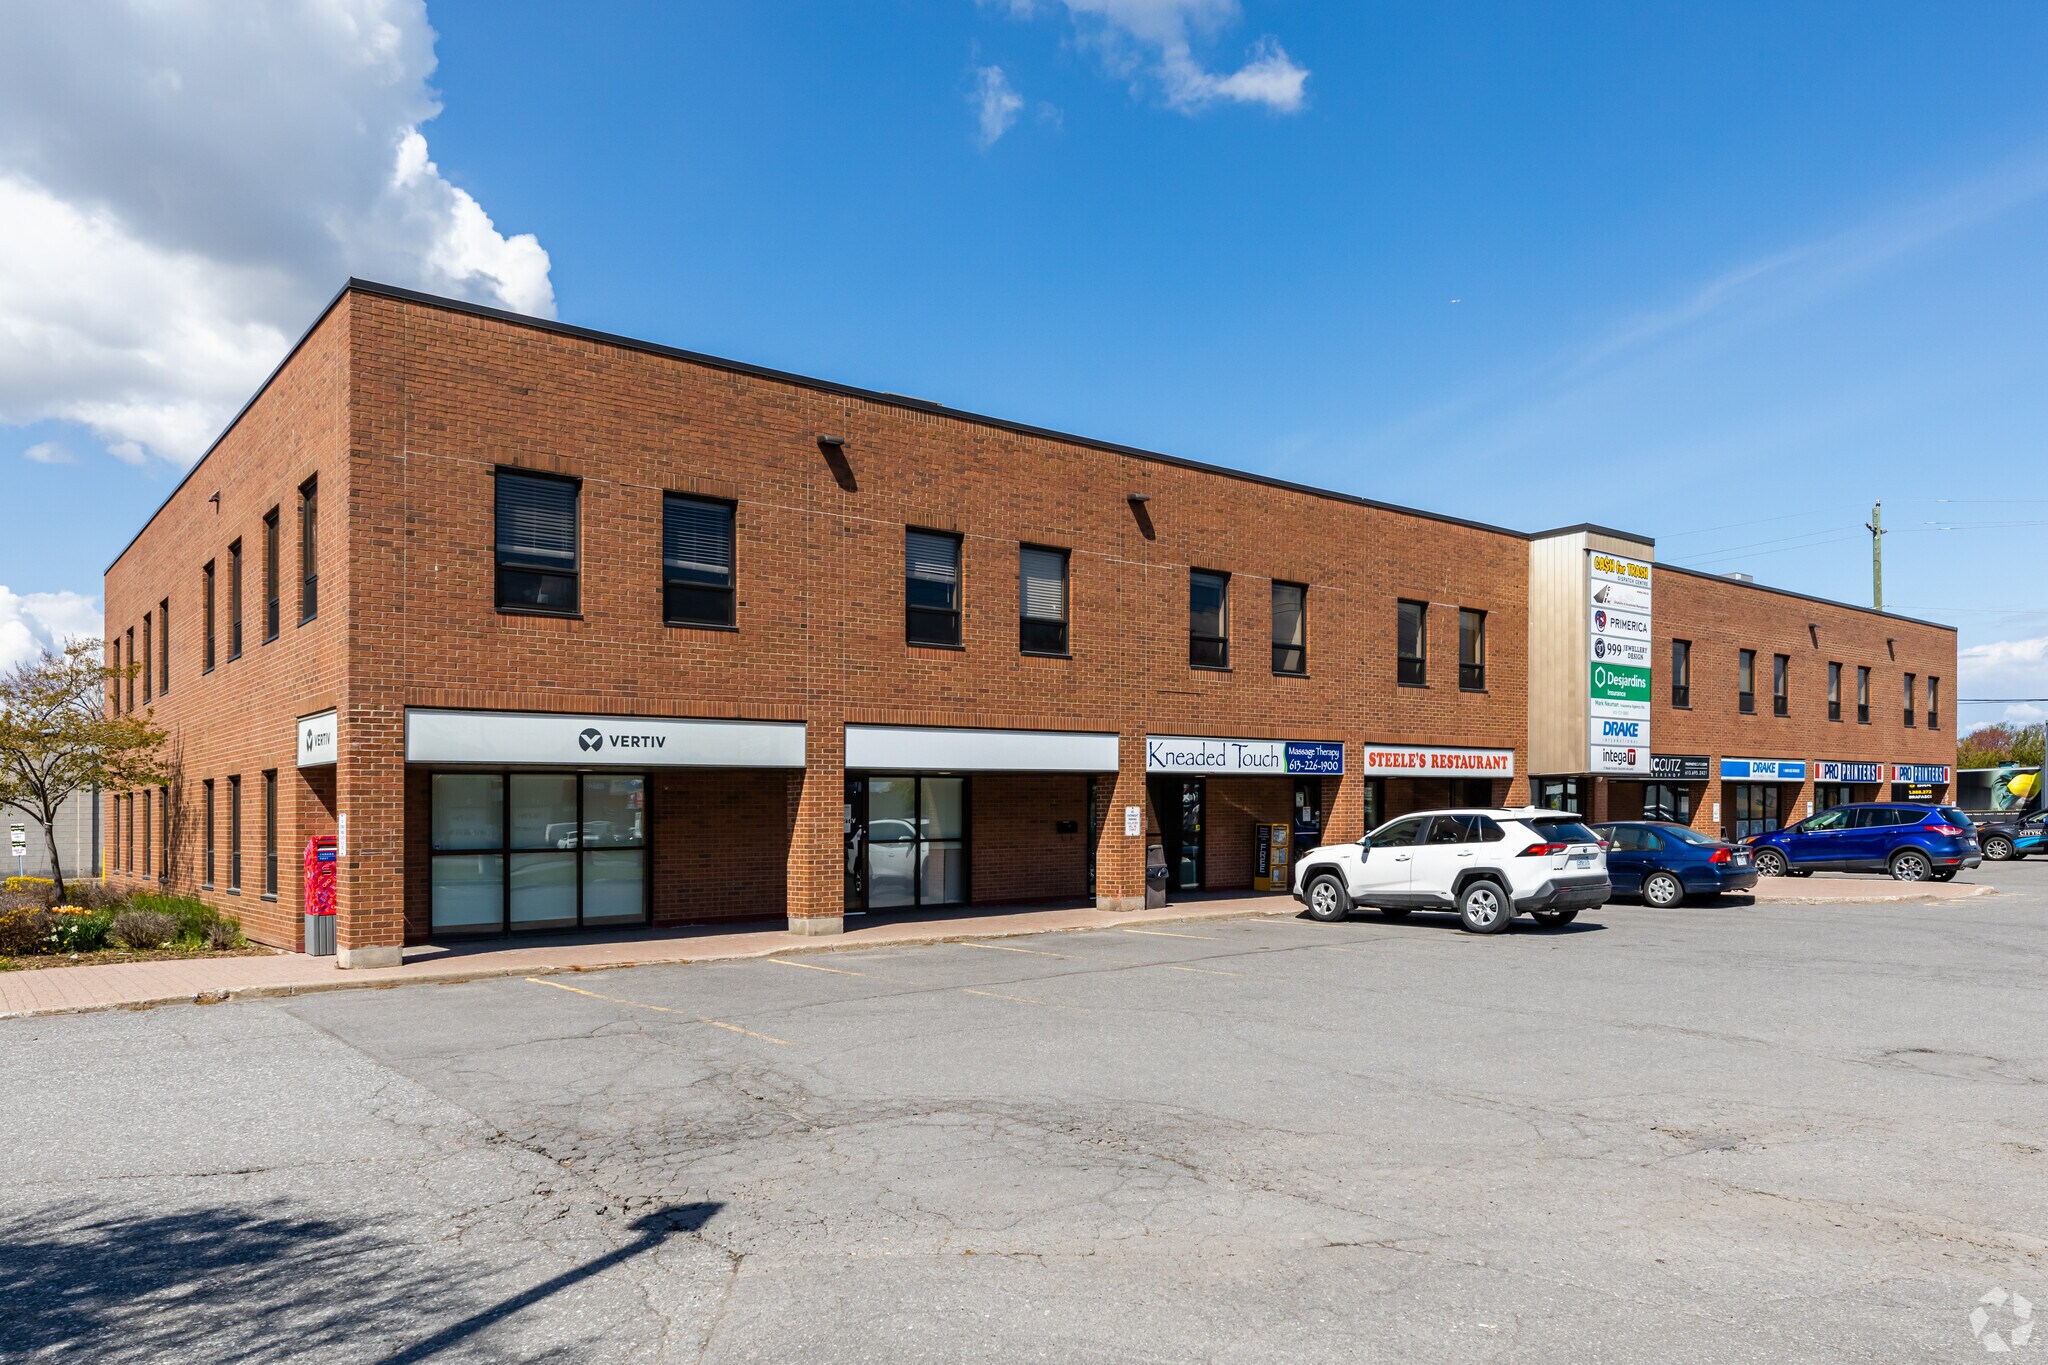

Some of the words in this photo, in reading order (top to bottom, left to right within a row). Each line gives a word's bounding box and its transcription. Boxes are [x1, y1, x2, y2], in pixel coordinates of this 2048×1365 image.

[1616, 561, 1626, 575] for
[1627, 563, 1649, 580] TRASH
[1617, 576, 1634, 585] DISPATCH
[1610, 618, 1648, 633] PRIMERICA
[1607, 643, 1622, 657] 999
[1623, 644, 1648, 654] JEWELLERY
[1607, 671, 1646, 688] Desjardins
[1607, 689, 1626, 697] Insurance
[1603, 721, 1639, 737] DRAKE
[314, 732, 330, 747] VERTIV
[609, 735, 666, 748] VERTIV
[1149, 741, 1226, 768] Kneaded
[1232, 743, 1279, 769] Touch
[1288, 747, 1315, 759] Massage
[1316, 745, 1340, 760] Therapy
[1289, 759, 1339, 772] 613-226-1900
[1369, 752, 1426, 768] STEELE'S
[1431, 754, 1508, 770] RESTAURANT
[1752, 762, 1776, 773] DRAKE
[1825, 764, 1839, 779] PRO
[1842, 763, 1876, 780] PRINTERS
[1900, 766, 1911, 780] PRO
[1914, 766, 1943, 782] PRINTERS
[1259, 843, 1267, 873] FREE
